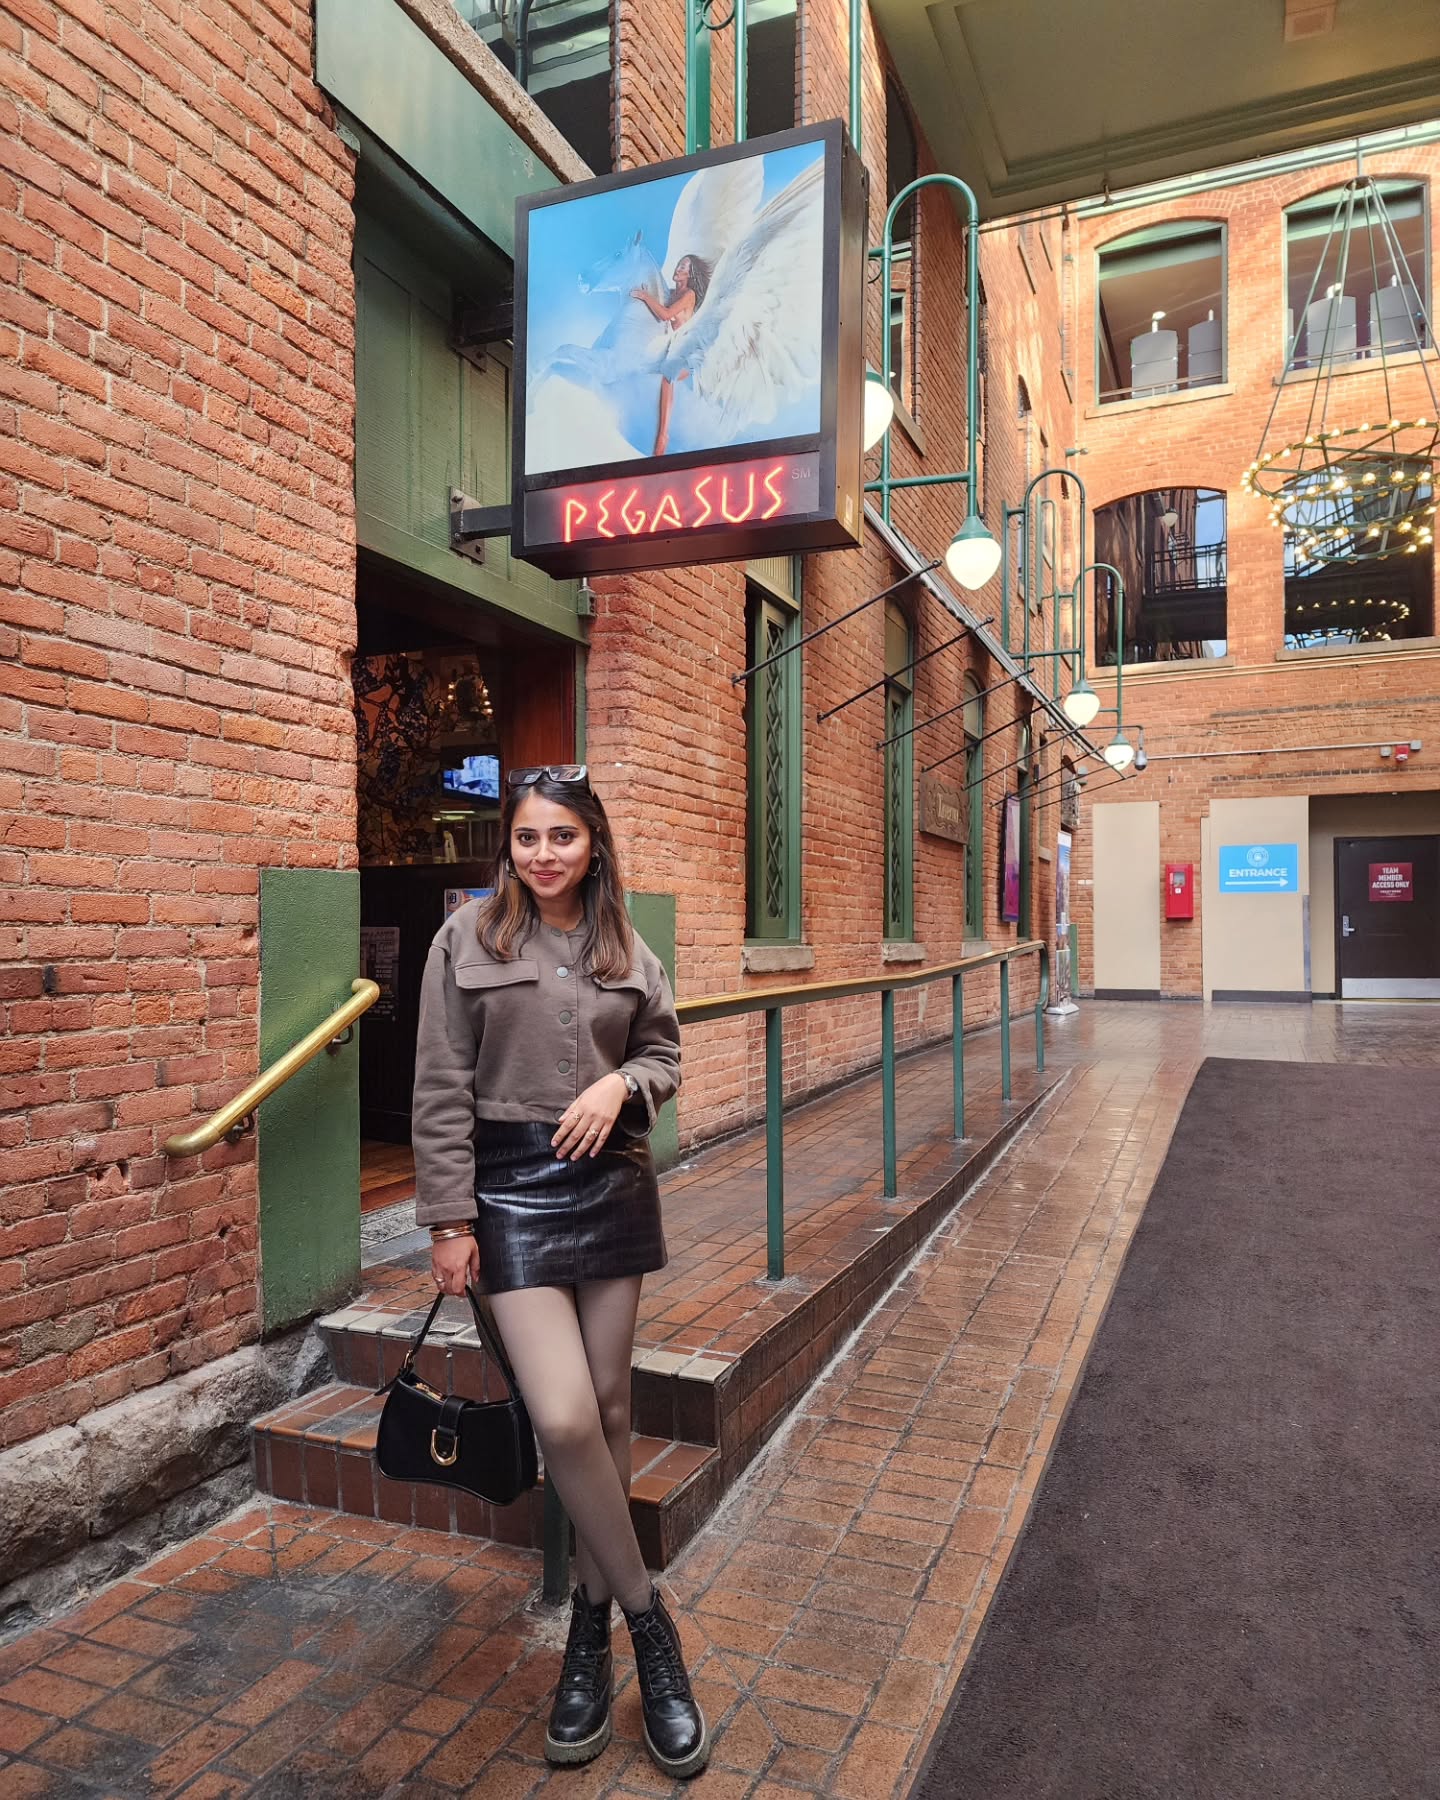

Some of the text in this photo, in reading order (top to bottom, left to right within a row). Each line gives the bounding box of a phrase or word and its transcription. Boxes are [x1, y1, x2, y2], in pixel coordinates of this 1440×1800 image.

[564, 465, 811, 543] PEGASUS SM
[1228, 867, 1288, 878] ENTRANCE
[1372, 881, 1394, 889] ACCESS
